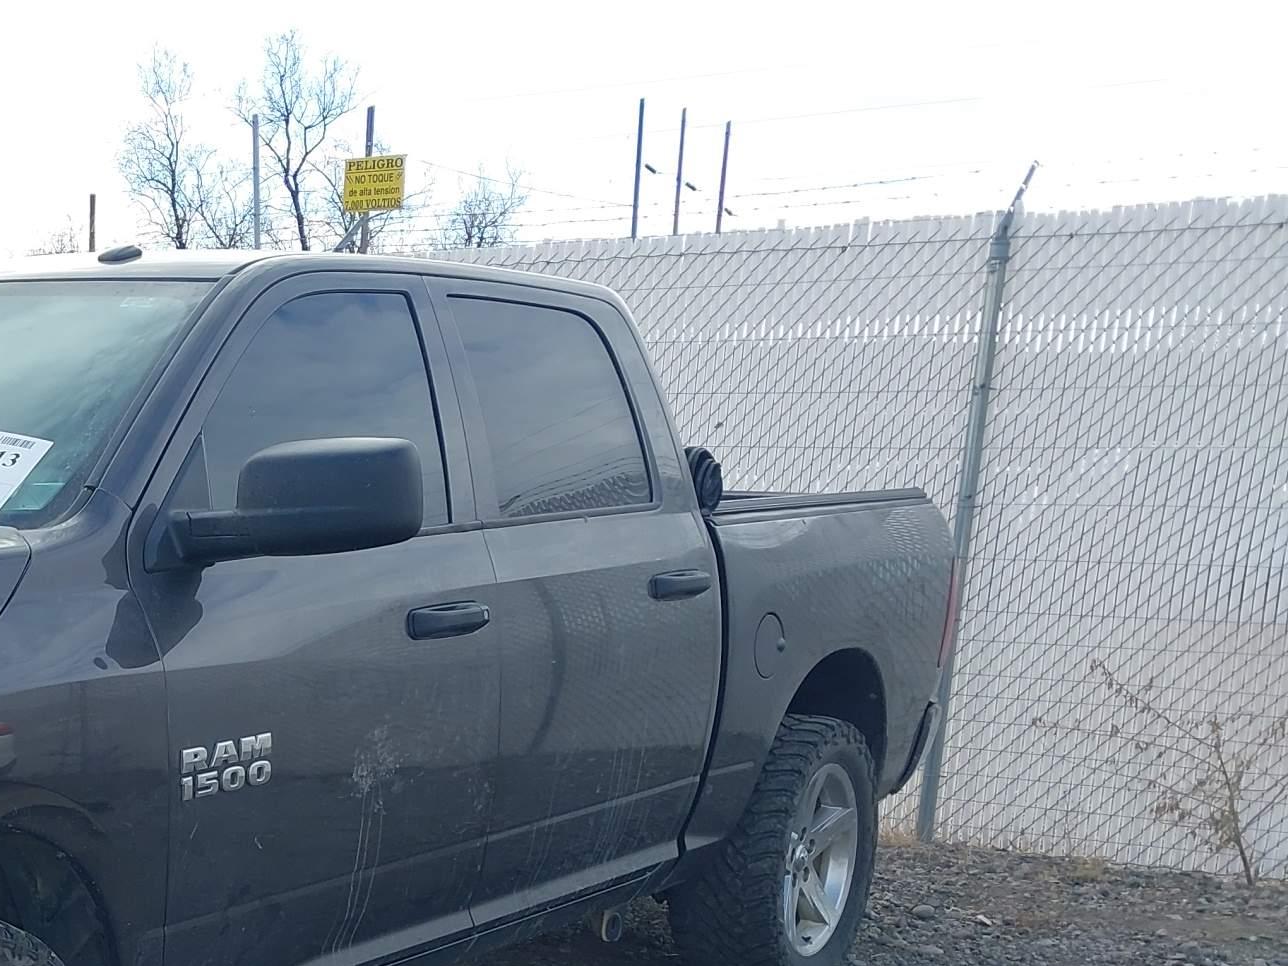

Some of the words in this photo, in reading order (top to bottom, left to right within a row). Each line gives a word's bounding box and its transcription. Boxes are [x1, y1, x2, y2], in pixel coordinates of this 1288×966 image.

[348, 158, 403, 171] PELIGRO
[355, 175, 366, 184] NO
[368, 173, 394, 183] TOQUE
[349, 188, 358, 197] de
[359, 186, 372, 196] alta
[366, 198, 401, 208] VOLTIOS
[181, 732, 272, 774] RAM
[181, 760, 272, 801] 1500
